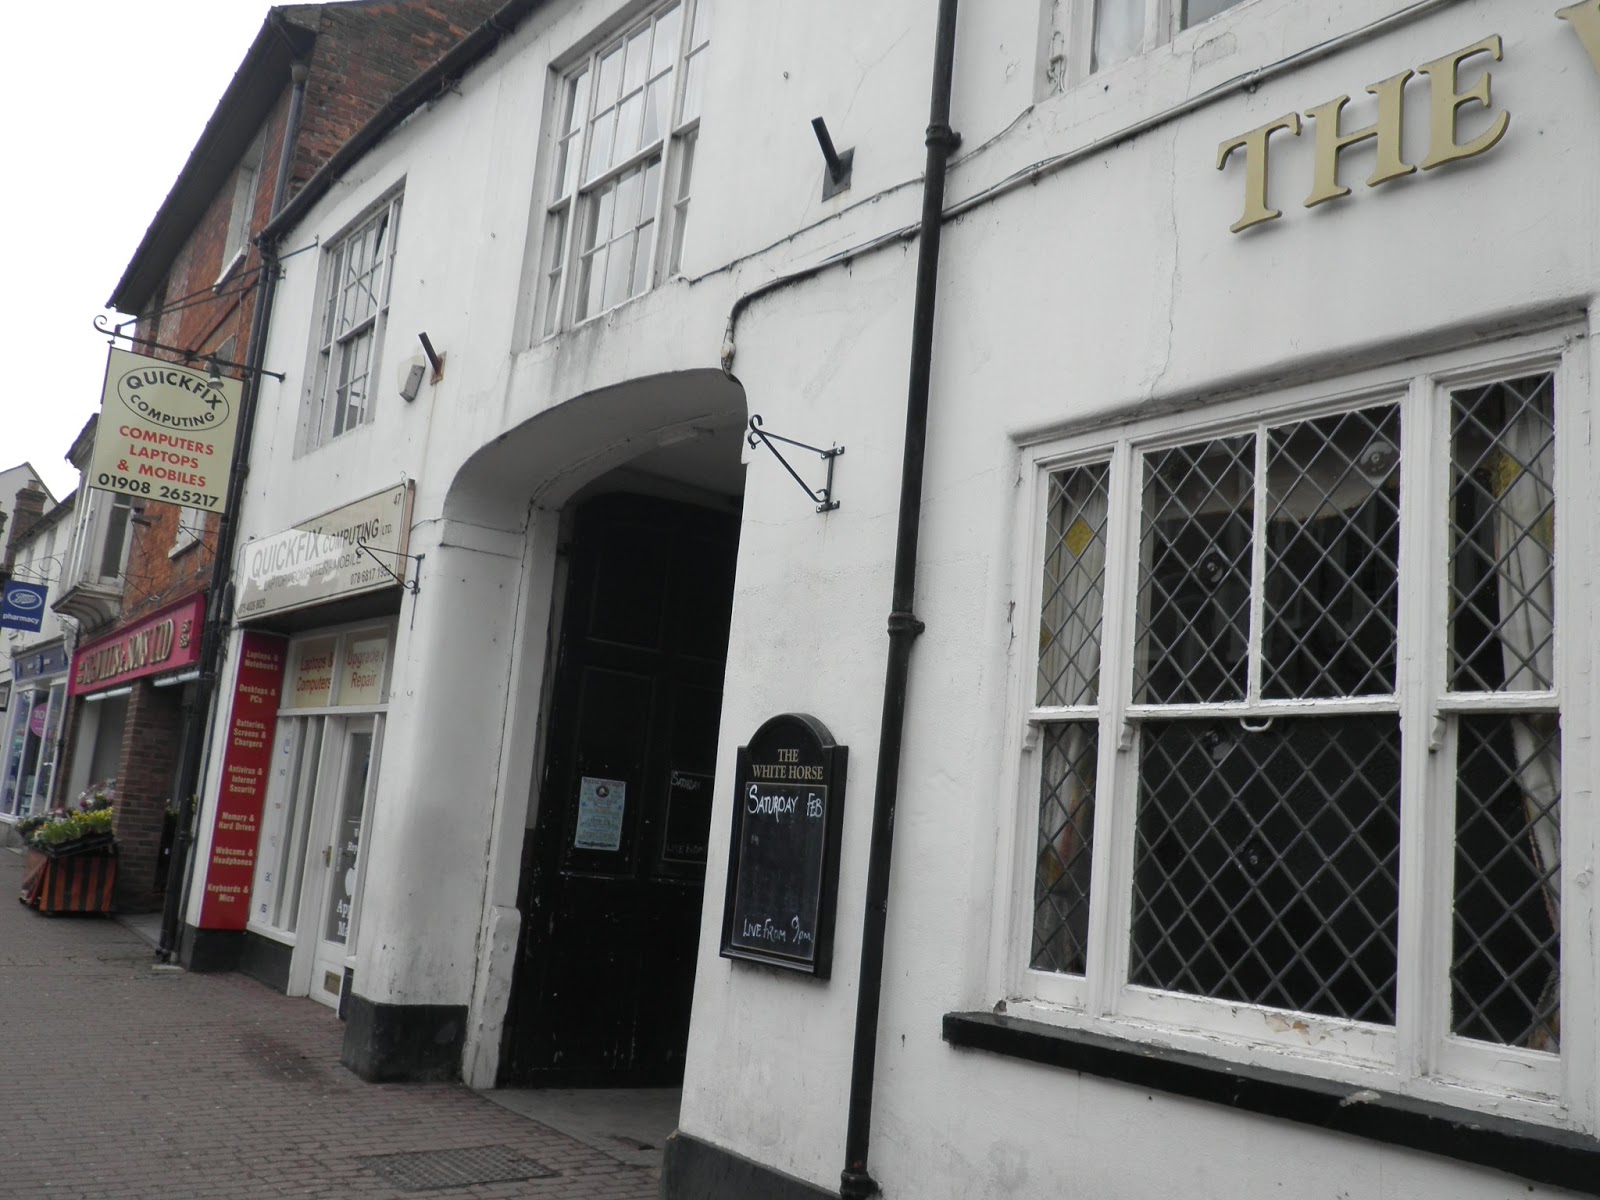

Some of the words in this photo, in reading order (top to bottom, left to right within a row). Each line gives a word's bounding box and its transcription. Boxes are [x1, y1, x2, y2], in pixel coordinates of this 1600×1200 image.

[1216, 33, 1510, 234] THE
[126, 370, 222, 411] QUICKFIX
[130, 394, 215, 427] COMPUTING
[119, 425, 214, 455] COMPUTERS
[129, 444, 199, 469] LAPTOPS
[117, 459, 129, 472] &
[138, 463, 206, 488] MOBILES
[98, 473, 151, 494] 01908
[160, 485, 219, 507] 265217
[393, 493, 402, 506] 47
[252, 526, 322, 579] QUICKFIX
[323, 518, 380, 554] COMPUTING
[2, 613, 40, 625] pharmacy
[350, 669, 377, 692] Repair
[777, 749, 799, 763] THE
[257, 767, 263, 776] &
[752, 764, 787, 779] WHITE
[788, 765, 824, 780] HORSE
[747, 784, 798, 822] SATURDAY
[806, 792, 823, 818] FEB
[221, 811, 247, 823] Memory
[248, 813, 255, 822] &
[218, 821, 233, 831] Hard
[234, 822, 256, 832] Drives
[215, 846, 246, 857] Webcams
[247, 848, 253, 857] &
[213, 856, 253, 867] Headphones
[207, 883, 241, 894] Keyboards
[242, 885, 249, 894] &
[218, 893, 235, 903] Mice
[743, 917, 762, 937] LIVE
